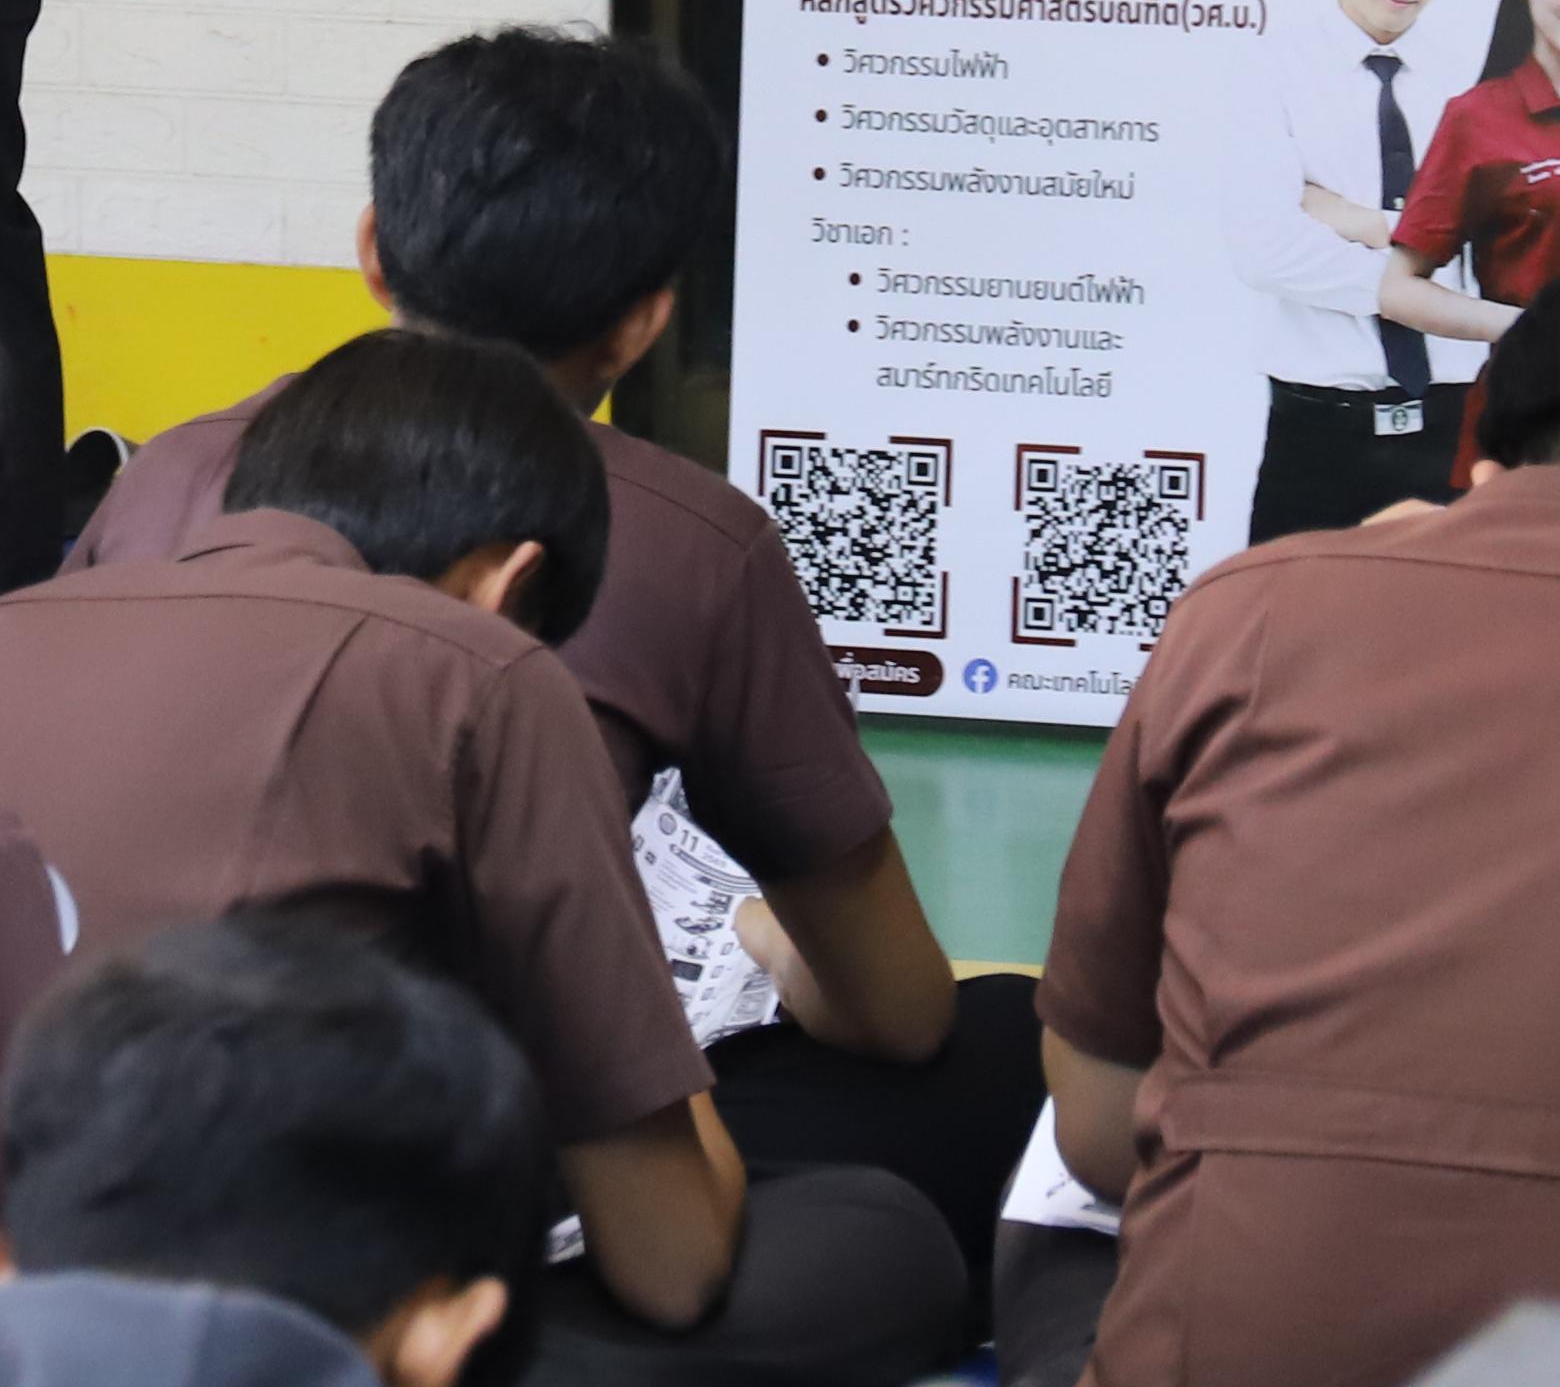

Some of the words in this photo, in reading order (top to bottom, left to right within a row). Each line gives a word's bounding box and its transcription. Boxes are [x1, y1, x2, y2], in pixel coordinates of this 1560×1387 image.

[843, 47, 1010, 81] วิศวกรรมไฟฟ้า
[810, 217, 893, 248] วิชาเอก
[874, 315, 1125, 353] วิศวกรรมพลังงานและ
[1007, 670, 1138, 696] คณะเทคโนโล
